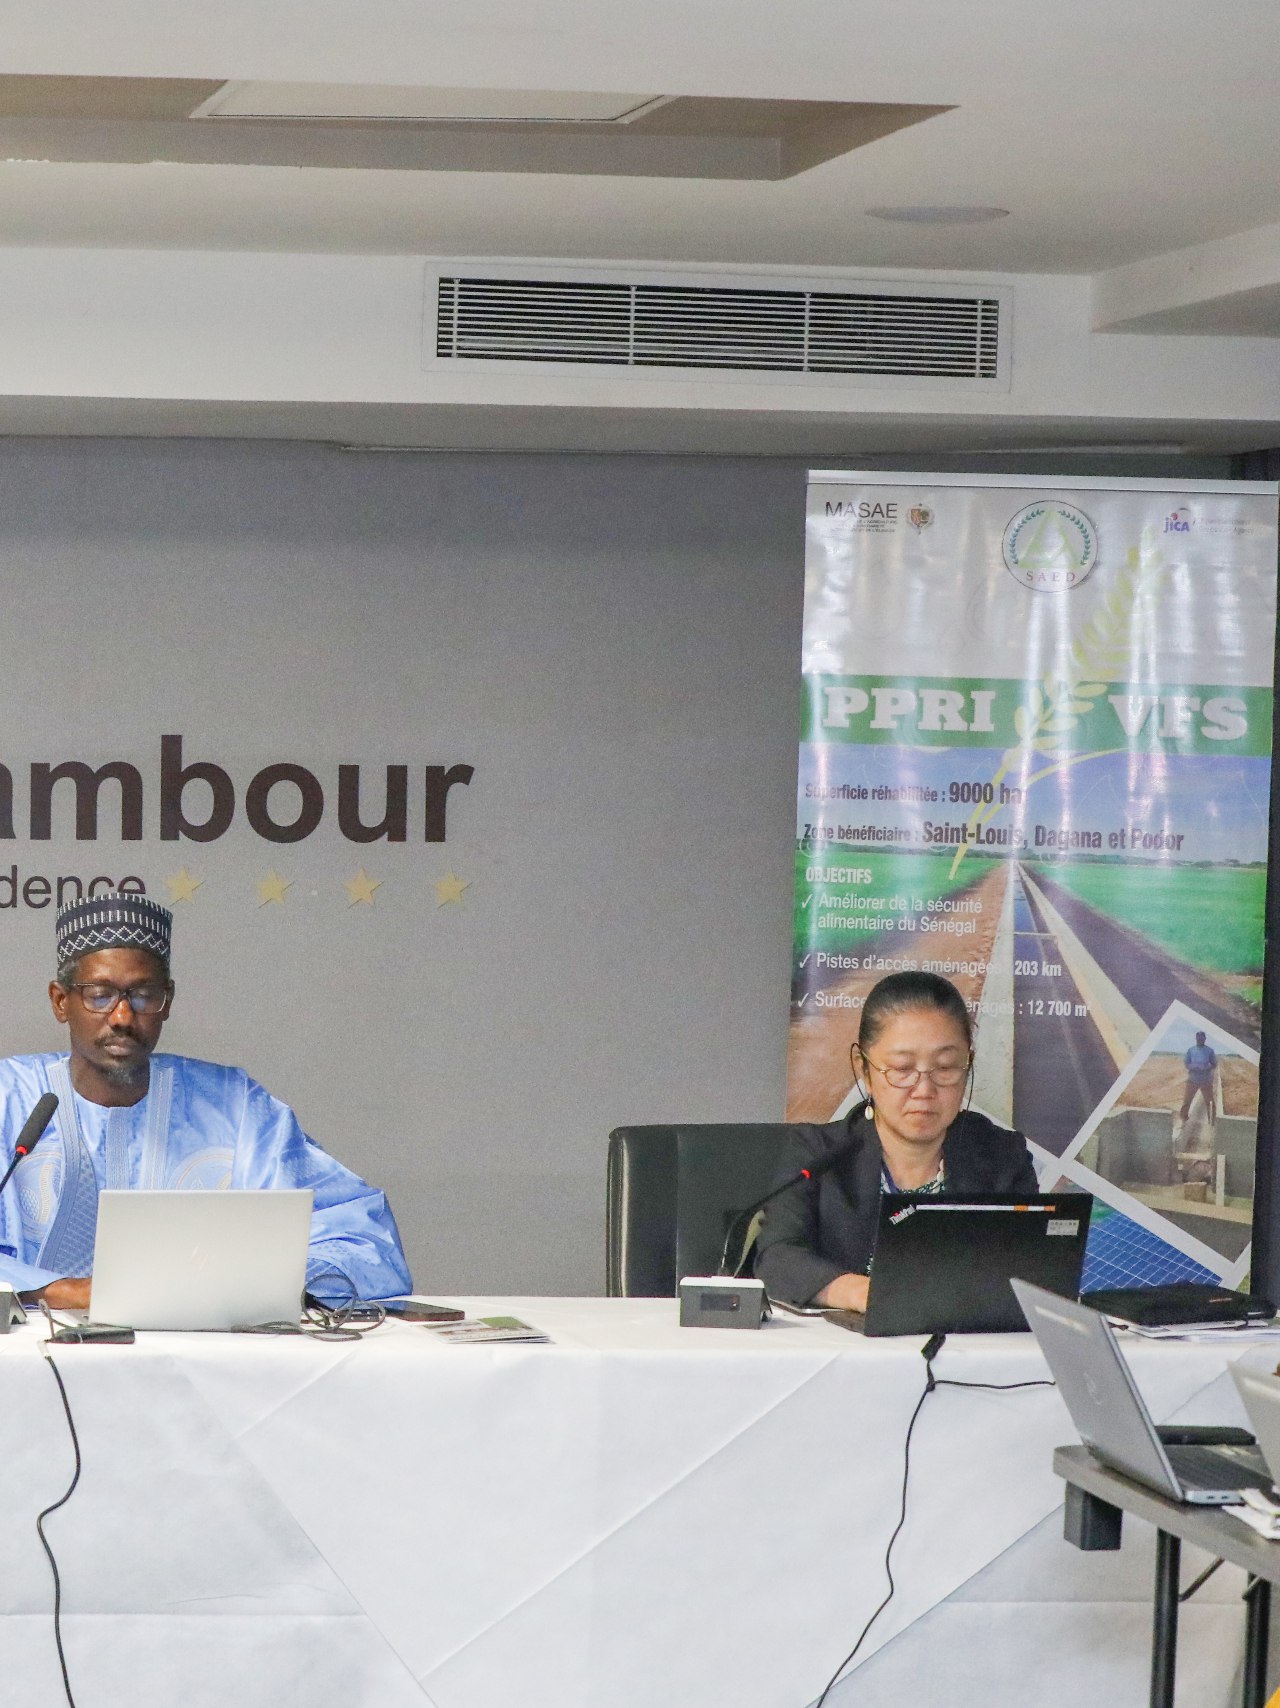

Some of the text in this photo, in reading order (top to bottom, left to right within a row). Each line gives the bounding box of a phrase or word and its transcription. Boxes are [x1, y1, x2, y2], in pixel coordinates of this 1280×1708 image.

[825, 501, 898, 519] MASAE
[1025, 571, 1076, 581] SAED
[823, 687, 1248, 740] PPRI VFS
[871, 785, 938, 802] réhabilitée
[949, 782, 994, 804] 9000
[999, 783, 1022, 804] ha
[804, 824, 834, 839] Zone
[837, 825, 911, 841] bénéficiaire
[922, 821, 1028, 850] Saint-Louis,
[1035, 825, 1102, 850] Dagana
[1108, 828, 1126, 849] et
[1131, 828, 1184, 851] Podor
[806, 867, 872, 884] OBJECTIFS
[819, 893, 983, 914] Améliorer de la sécurité
[818, 914, 976, 937] alimentaire du Sénégal
[816, 952, 859, 969] Pistes
[862, 954, 918, 972] d'accès
[1015, 960, 1039, 976] 203
[1042, 961, 1062, 977] km
[1027, 1000, 1044, 1015] 12
[1047, 1000, 1072, 1016] 700
